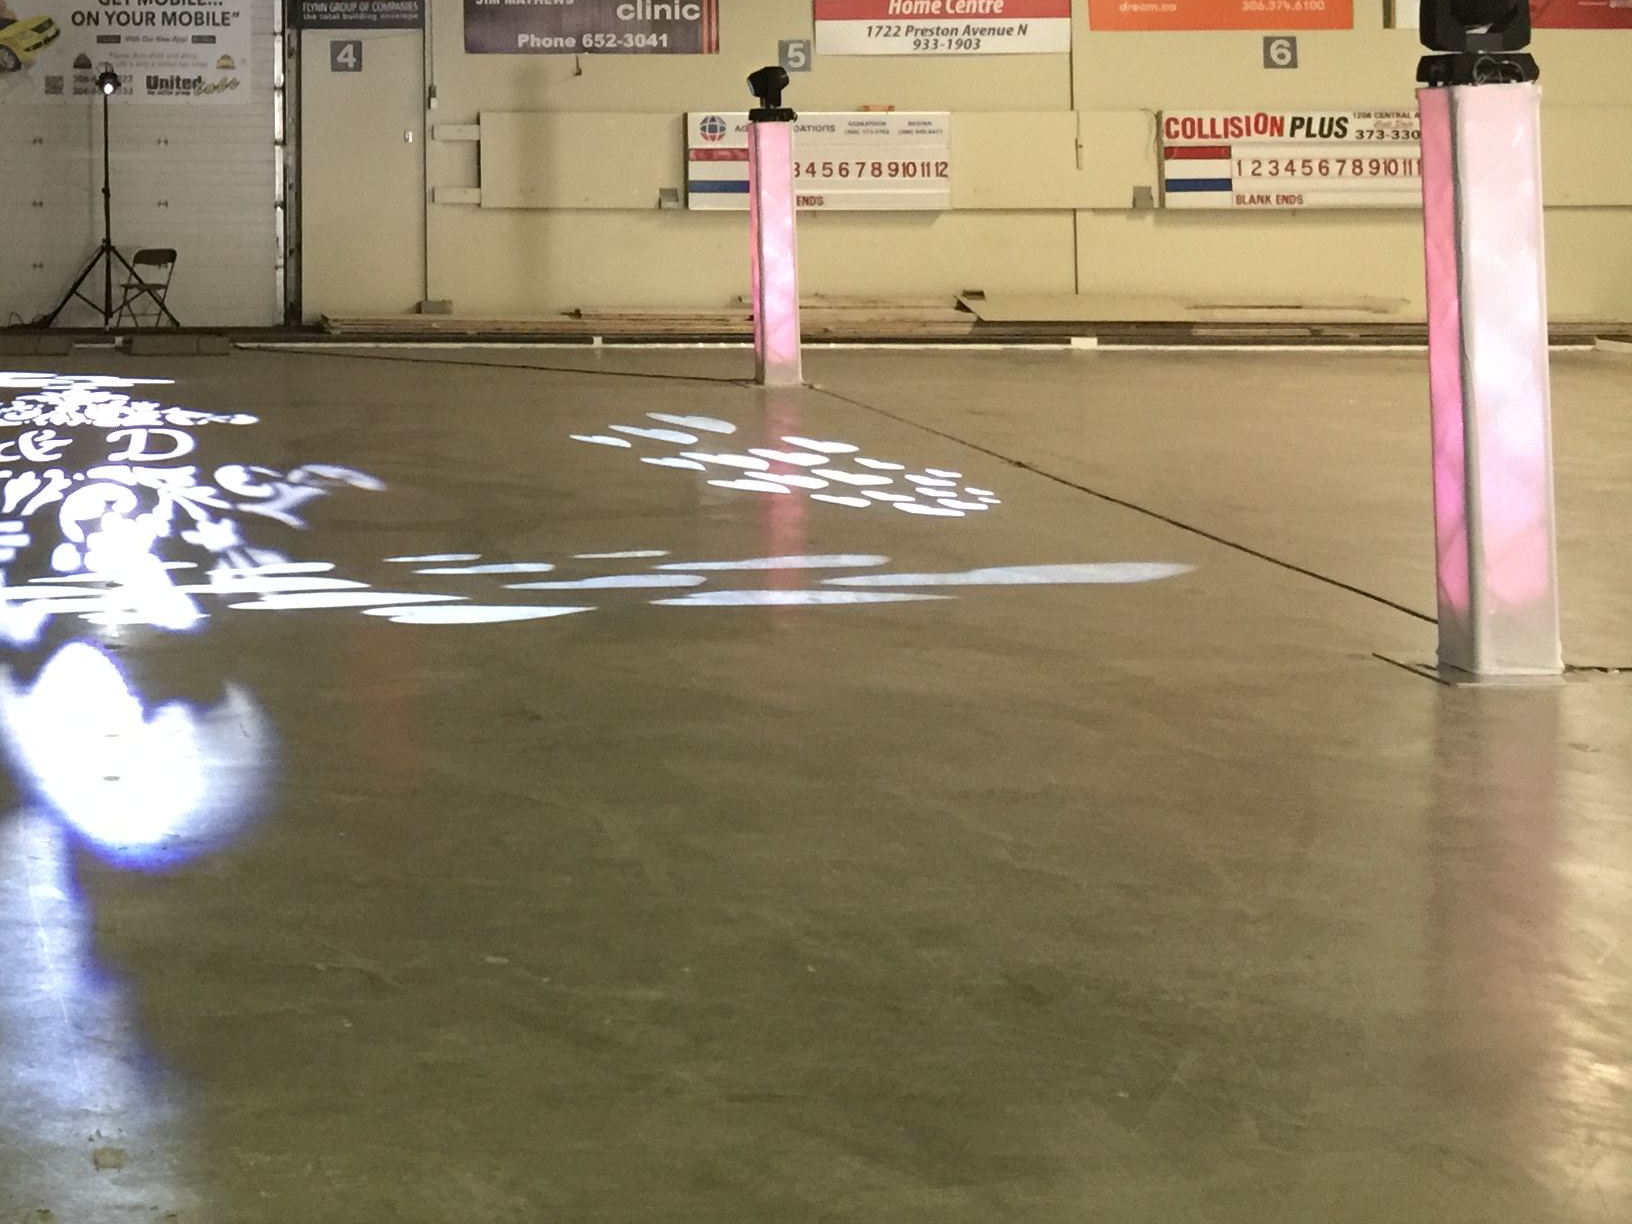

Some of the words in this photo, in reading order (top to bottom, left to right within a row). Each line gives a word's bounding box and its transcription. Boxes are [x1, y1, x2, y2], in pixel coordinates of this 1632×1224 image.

[71, 10, 100, 27] ON
[104, 10, 155, 27] YOUR
[616, 0, 700, 20] clinic
[866, 26, 902, 38] 1722
[905, 25, 958, 38] Preston
[961, 25, 1013, 37] Avenue
[1017, 24, 1028, 36] N
[518, 33, 576, 48] Phone
[582, 33, 668, 48] 652-3041
[913, 38, 981, 51] 933-1903
[337, 44, 356, 68] 4
[787, 43, 806, 68] 5
[1269, 39, 1292, 66] 6
[1164, 112, 1285, 140] COLLISION
[1289, 116, 1349, 139] PLUS
[1355, 130, 1421, 140] 373-330
[805, 162, 816, 178] 4
[821, 162, 833, 178] 5
[838, 162, 850, 178] 6
[855, 162, 866, 178] 7
[870, 162, 883, 178] 8
[887, 162, 899, 178] 9
[902, 162, 917, 178] 10
[921, 162, 930, 178] 11
[935, 162, 949, 178] 12
[1236, 160, 1242, 177] 1
[1251, 160, 1263, 177] 2
[1268, 160, 1280, 177] 3
[1284, 160, 1297, 177] 4
[1301, 160, 1313, 177] 5
[1318, 160, 1330, 177] 6
[1336, 160, 1347, 177] 7
[1351, 160, 1364, 177] 8
[1368, 160, 1380, 177] 9
[1383, 160, 1399, 177] 10
[1402, 160, 1413, 177] 11
[797, 196, 824, 206] ENDS
[1235, 194, 1271, 205] BLANK
[1276, 194, 1304, 205] ENDS
[106, 428, 196, 463] D
